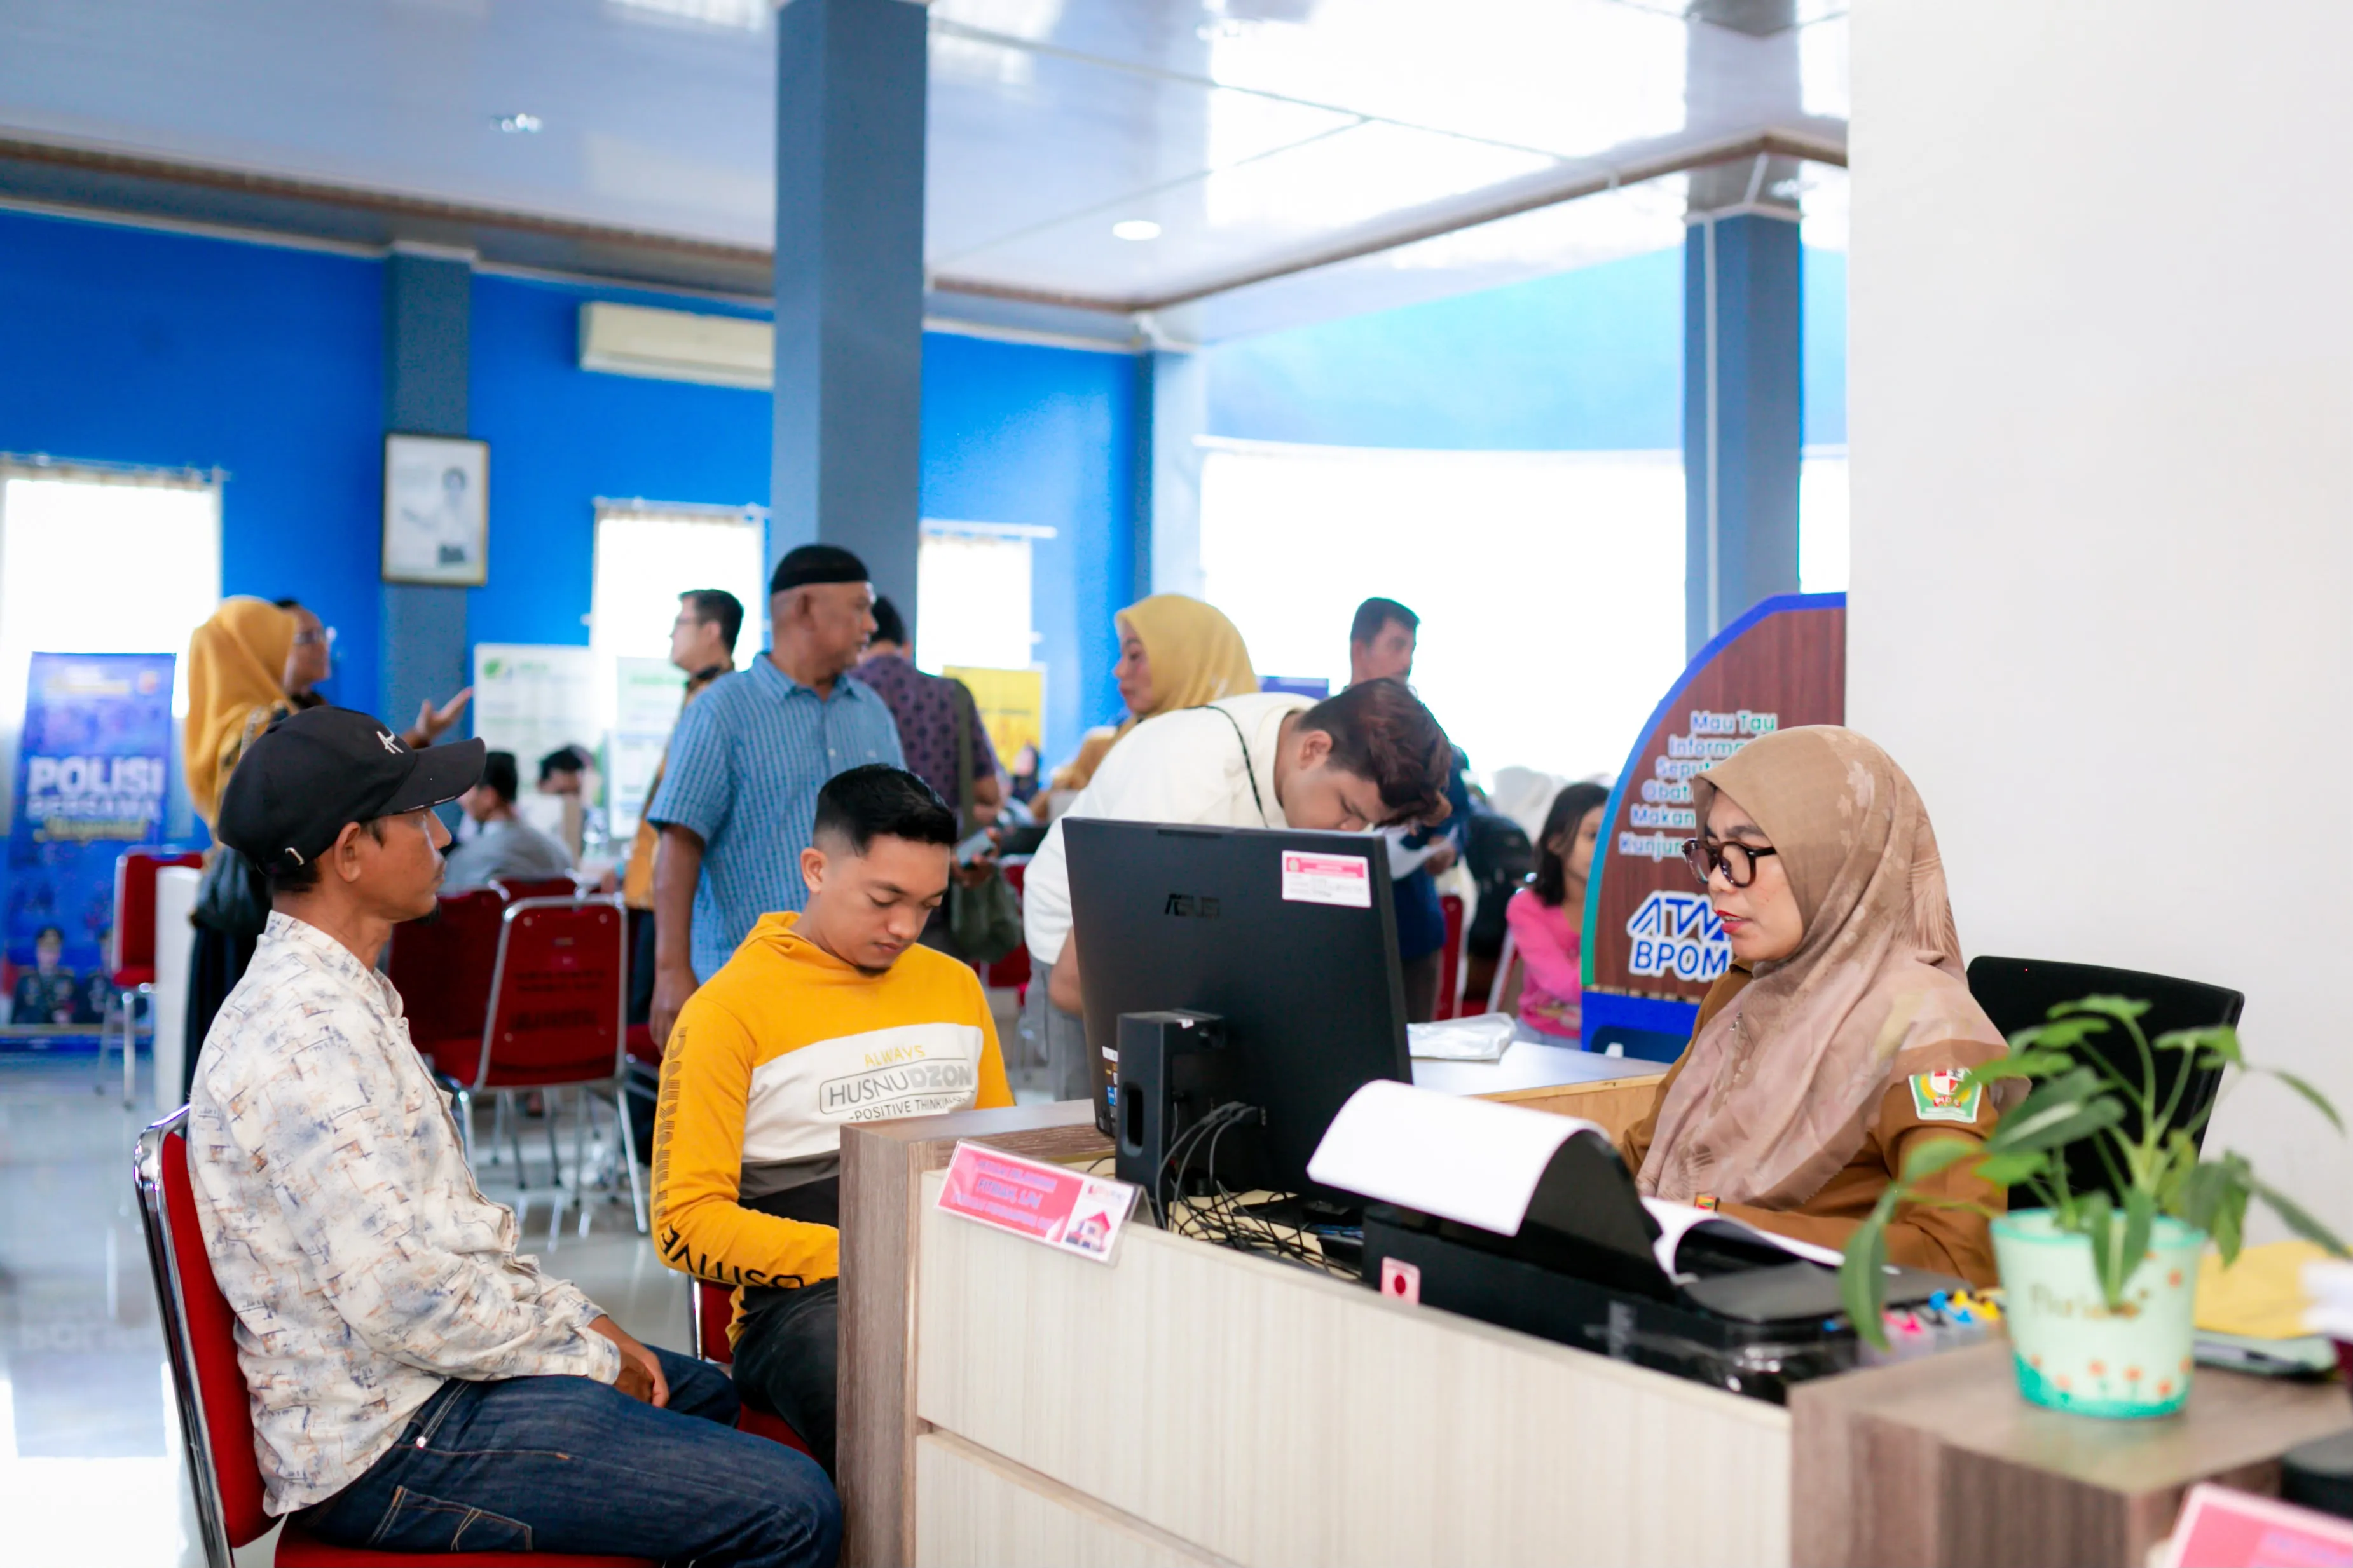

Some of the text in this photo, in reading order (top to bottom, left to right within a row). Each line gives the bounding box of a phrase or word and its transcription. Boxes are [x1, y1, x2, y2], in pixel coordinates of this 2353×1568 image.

[1692, 712, 1776, 732] Mau Tau
[1668, 735, 1745, 755] Inform
[27, 756, 164, 794] POLISI
[1631, 807, 1695, 826] Makan
[1620, 833, 1683, 858] Kunjun
[1635, 940, 1728, 977] BPOM
[865, 1044, 926, 1068] ALWAYS
[829, 1064, 973, 1107] HUSNUDZON
[661, 1224, 825, 1288] OSITIVE
